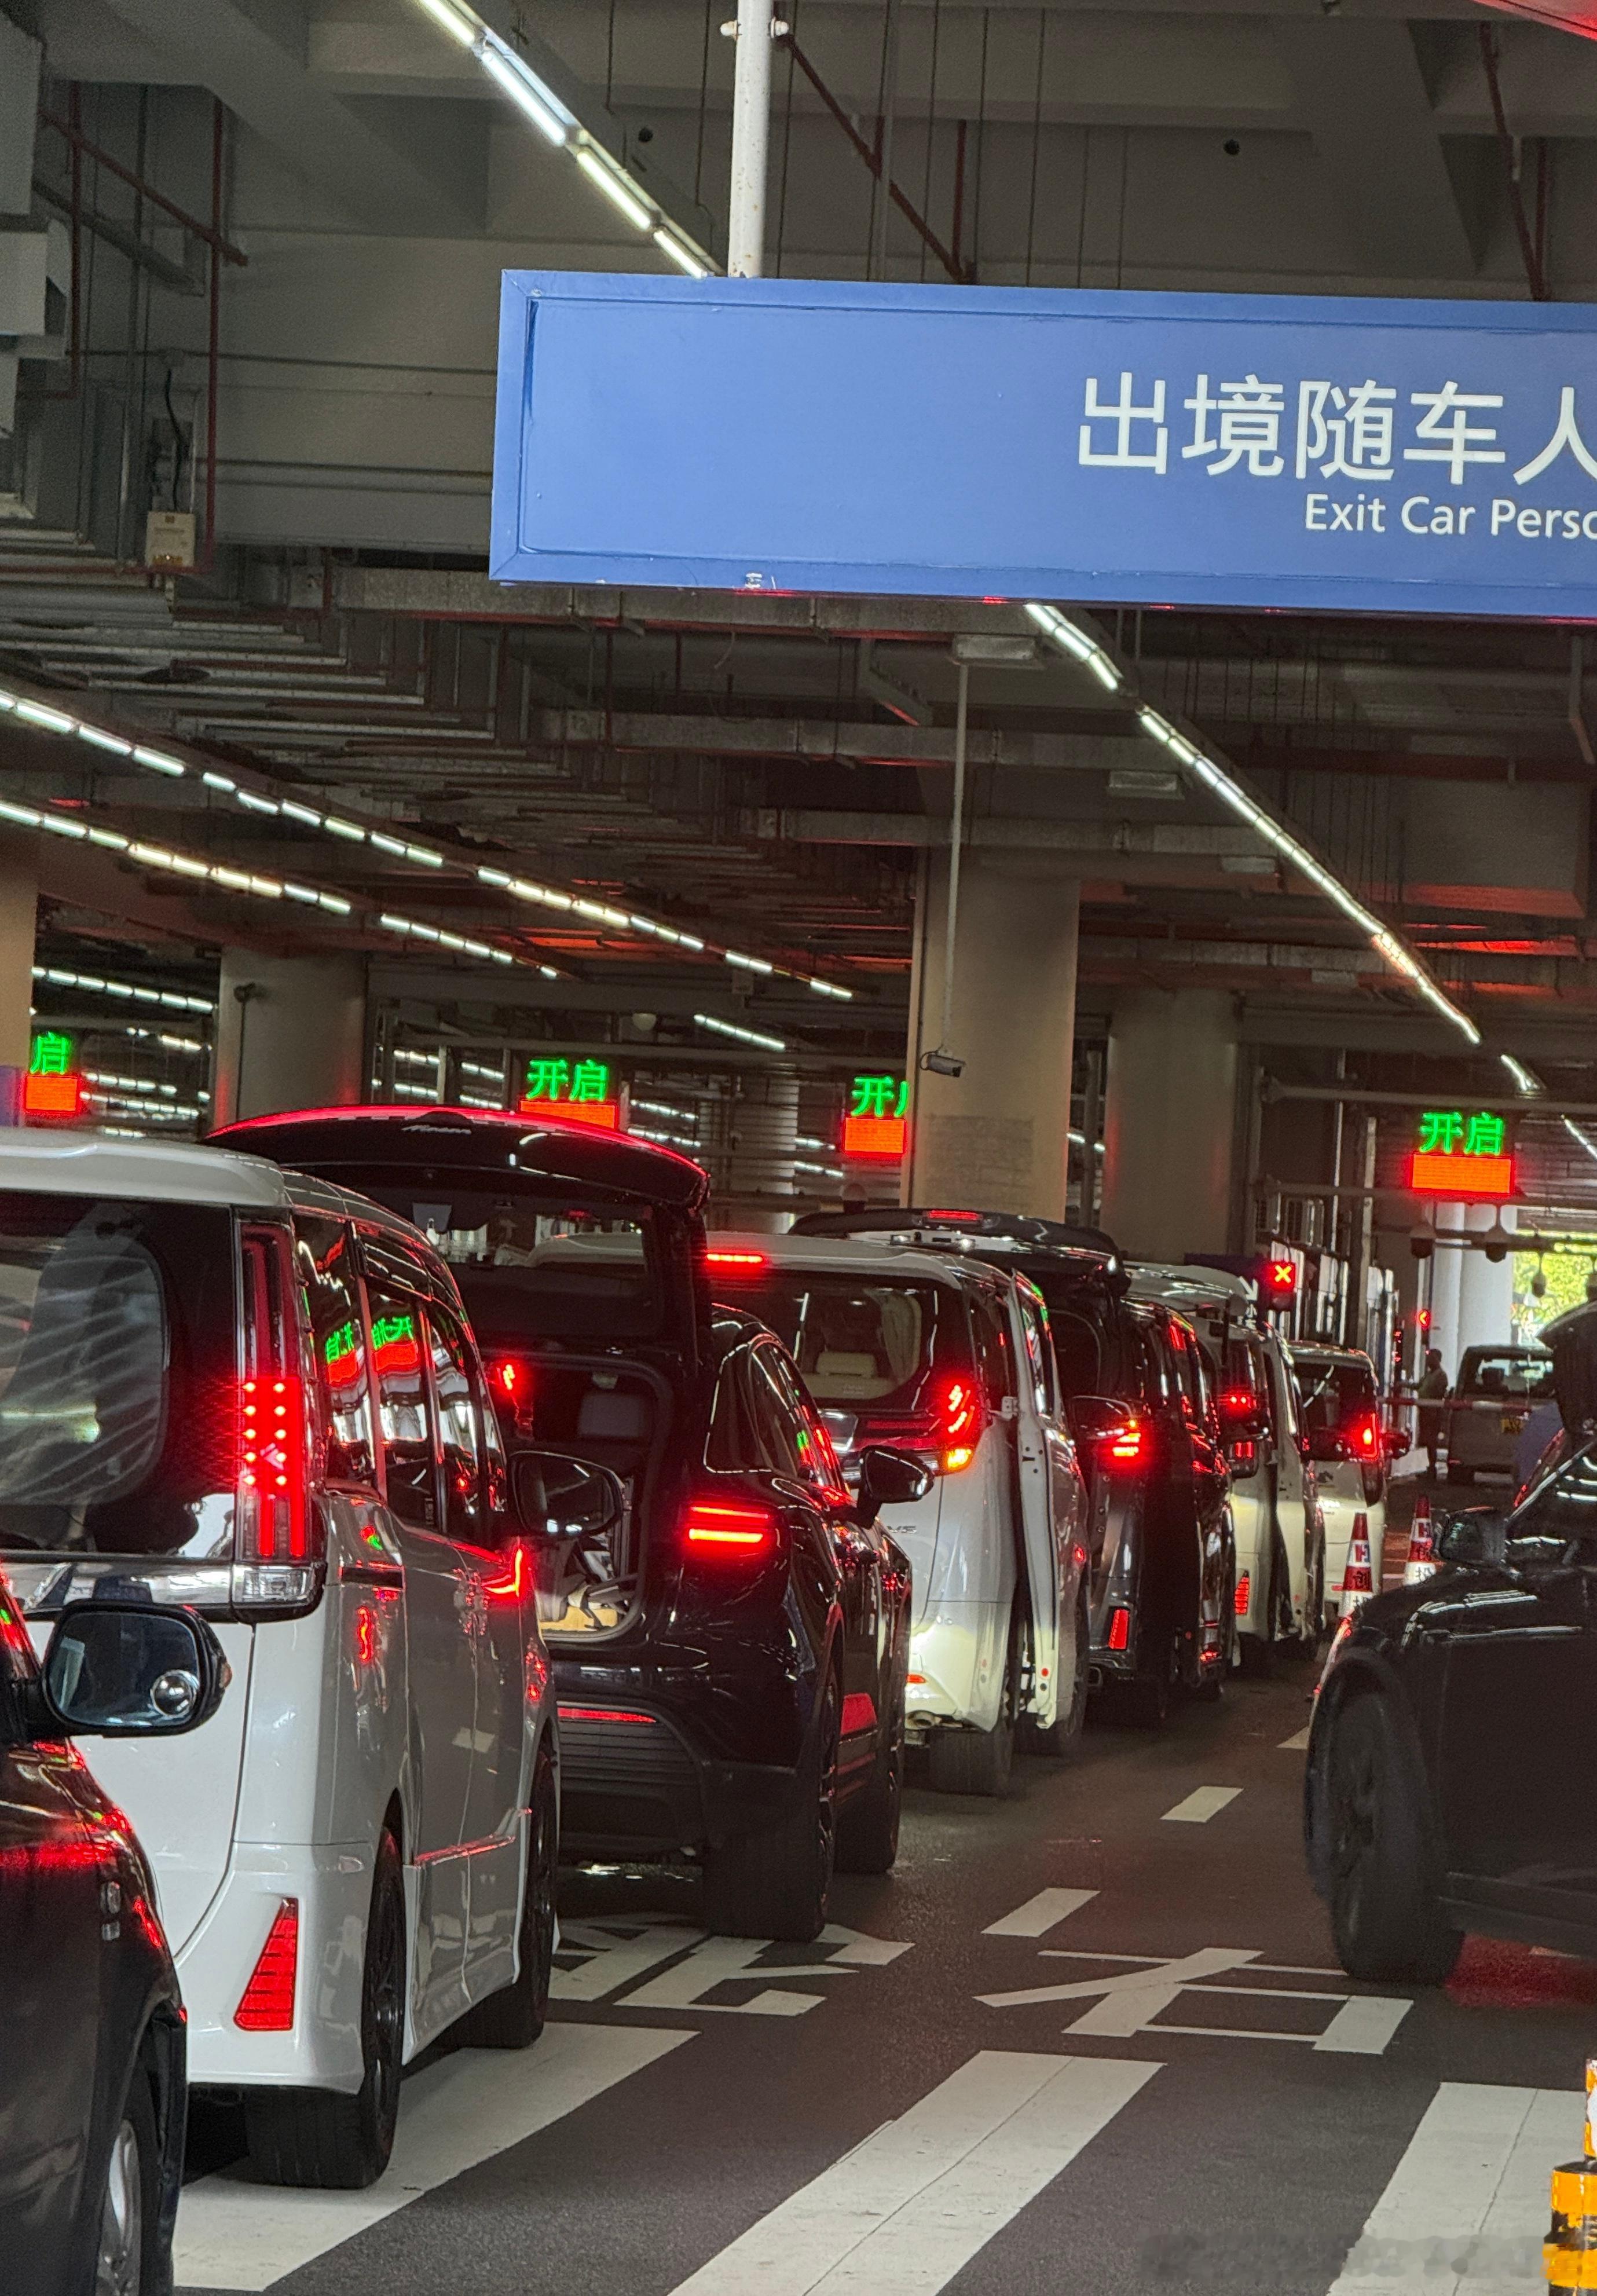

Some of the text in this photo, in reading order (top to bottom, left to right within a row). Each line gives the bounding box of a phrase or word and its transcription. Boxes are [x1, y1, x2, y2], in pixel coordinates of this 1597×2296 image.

[1079, 372, 1597, 485] 出境随车人
[1306, 493, 1386, 532] Exit
[1401, 496, 1475, 535] Car
[30, 1031, 71, 1074] 启
[526, 1059, 608, 1101] 开启
[1419, 1111, 1504, 1155] 开启
[972, 1947, 1415, 2055] 右
